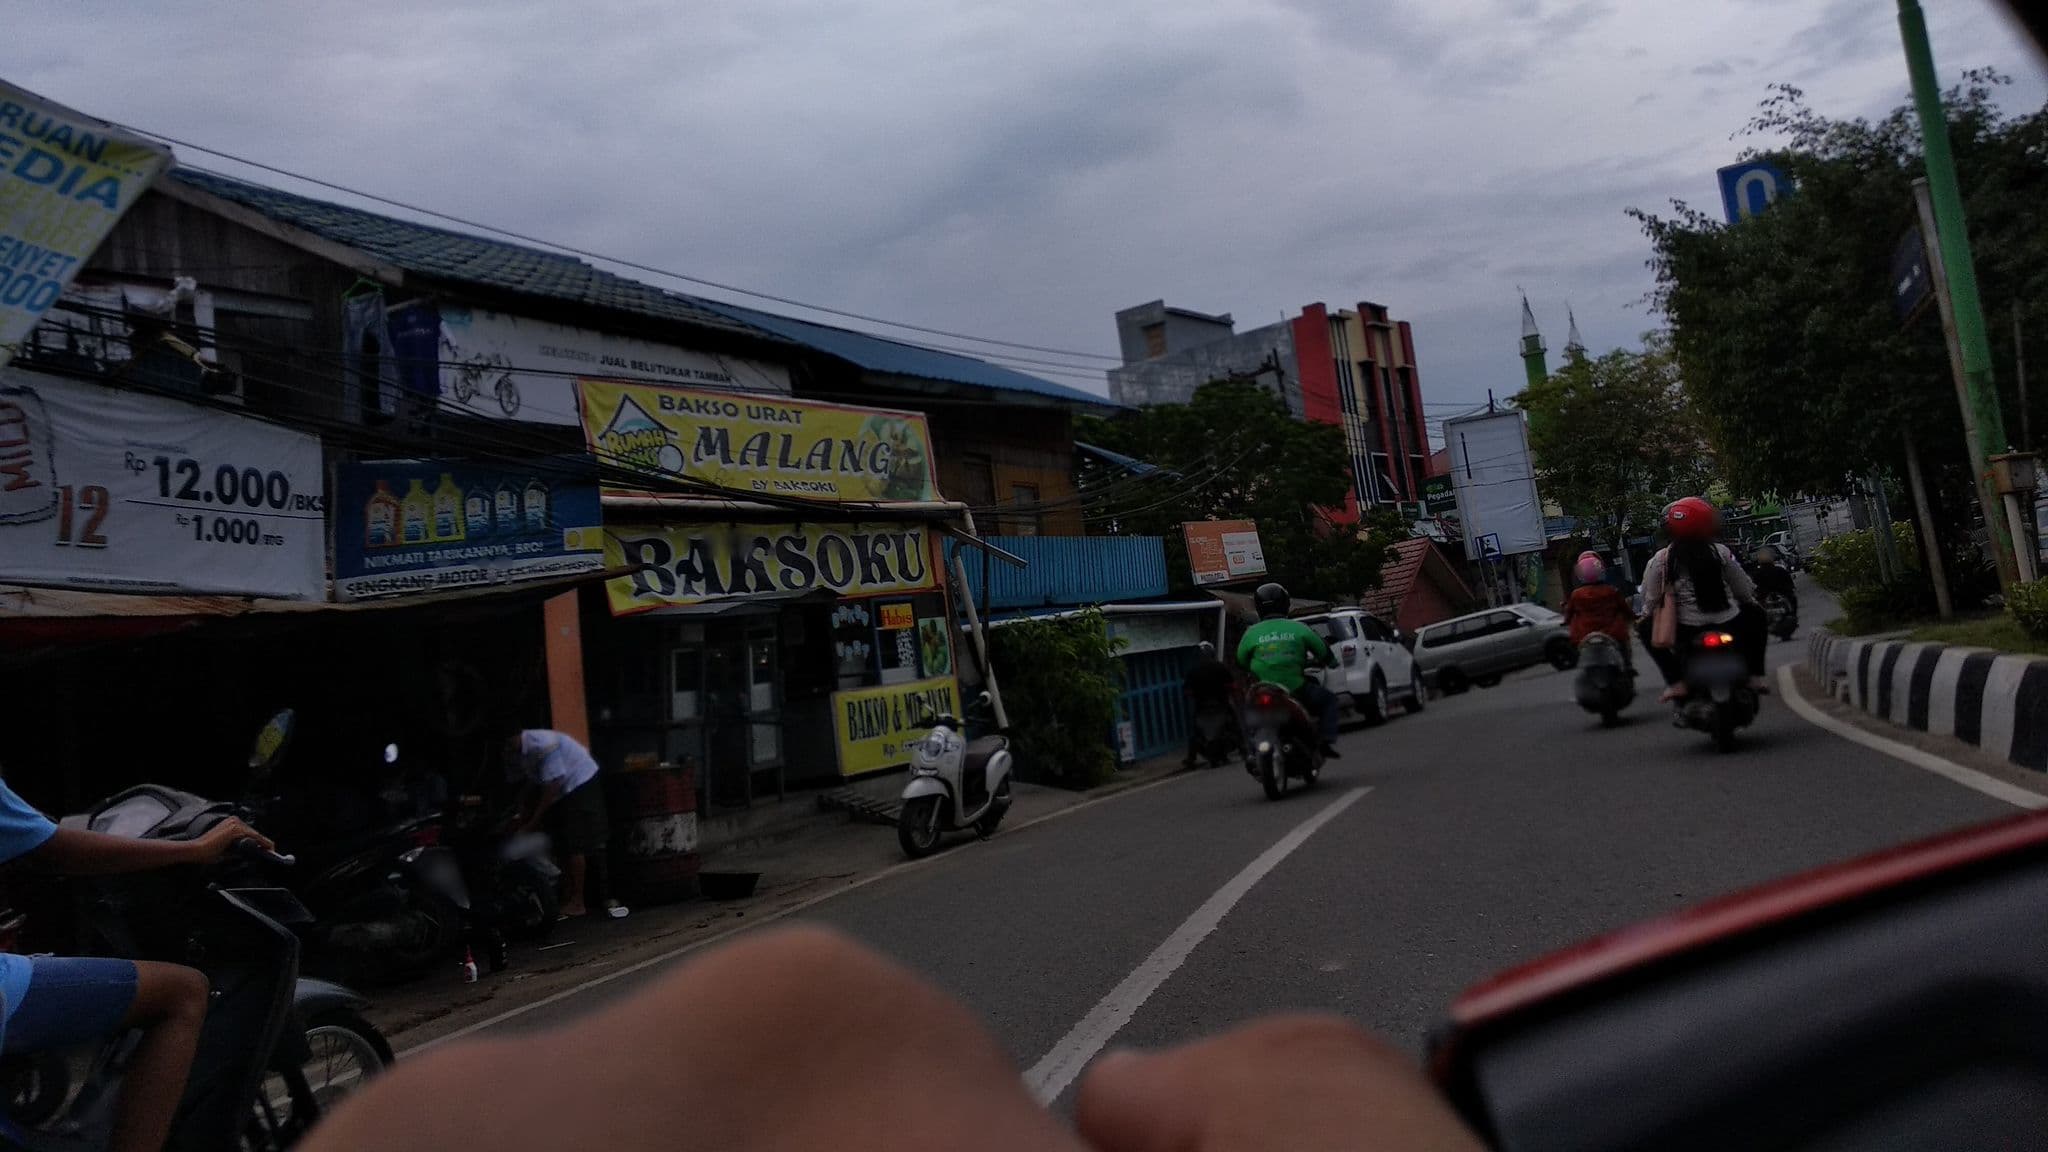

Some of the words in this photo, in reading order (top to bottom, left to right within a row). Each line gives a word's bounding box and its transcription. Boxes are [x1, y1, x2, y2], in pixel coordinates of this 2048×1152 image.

[600, 354, 626, 369] JUAL
[658, 394, 739, 418] BAKSO
[745, 405, 803, 426] URAT
[124, 450, 147, 477] Rp
[693, 425, 892, 478] MALANG
[751, 479, 769, 490] BY
[55, 485, 110, 549] 12
[192, 514, 260, 546] 1.000
[362, 551, 425, 569] NIKMATI
[621, 532, 936, 598] BAKSOKU
[847, 696, 889, 741] BAKSO
[893, 694, 902, 733] &
